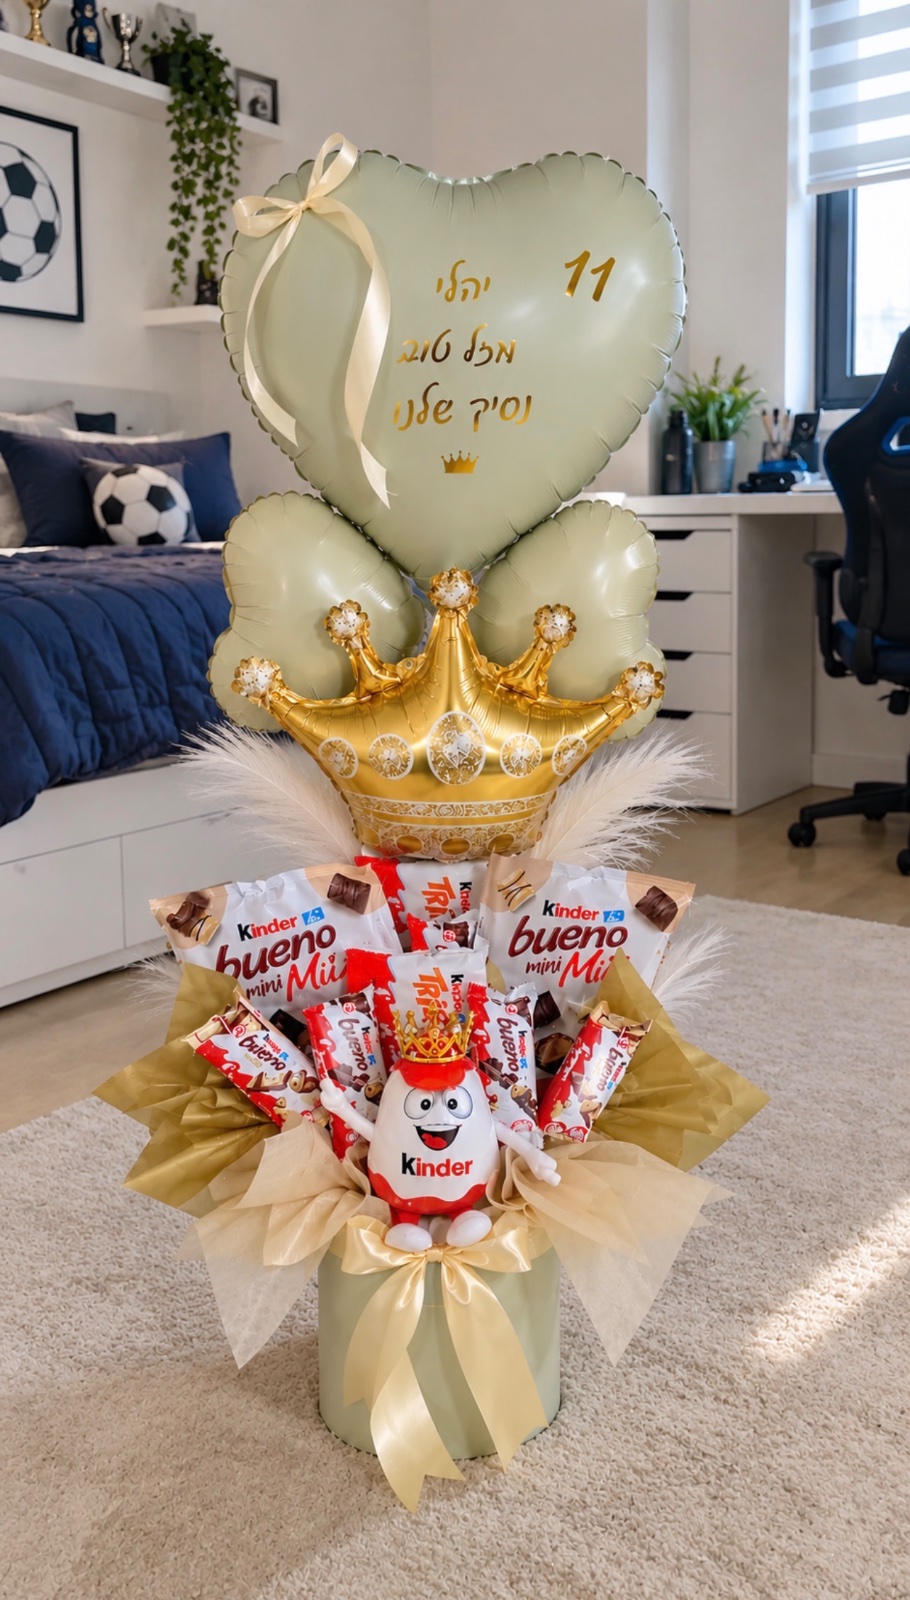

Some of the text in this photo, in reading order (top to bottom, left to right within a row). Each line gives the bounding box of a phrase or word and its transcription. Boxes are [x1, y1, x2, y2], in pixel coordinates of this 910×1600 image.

[436, 260, 491, 302] יהלי
[564, 250, 616, 302] 11
[397, 323, 516, 367] מזל טוב
[392, 382, 453, 431] שלנו
[215, 924, 336, 980] bueno
[508, 915, 628, 957] bueno
[246, 974, 283, 1000] mini
[525, 956, 562, 975] mini
[496, 1017, 519, 1072] bueno
